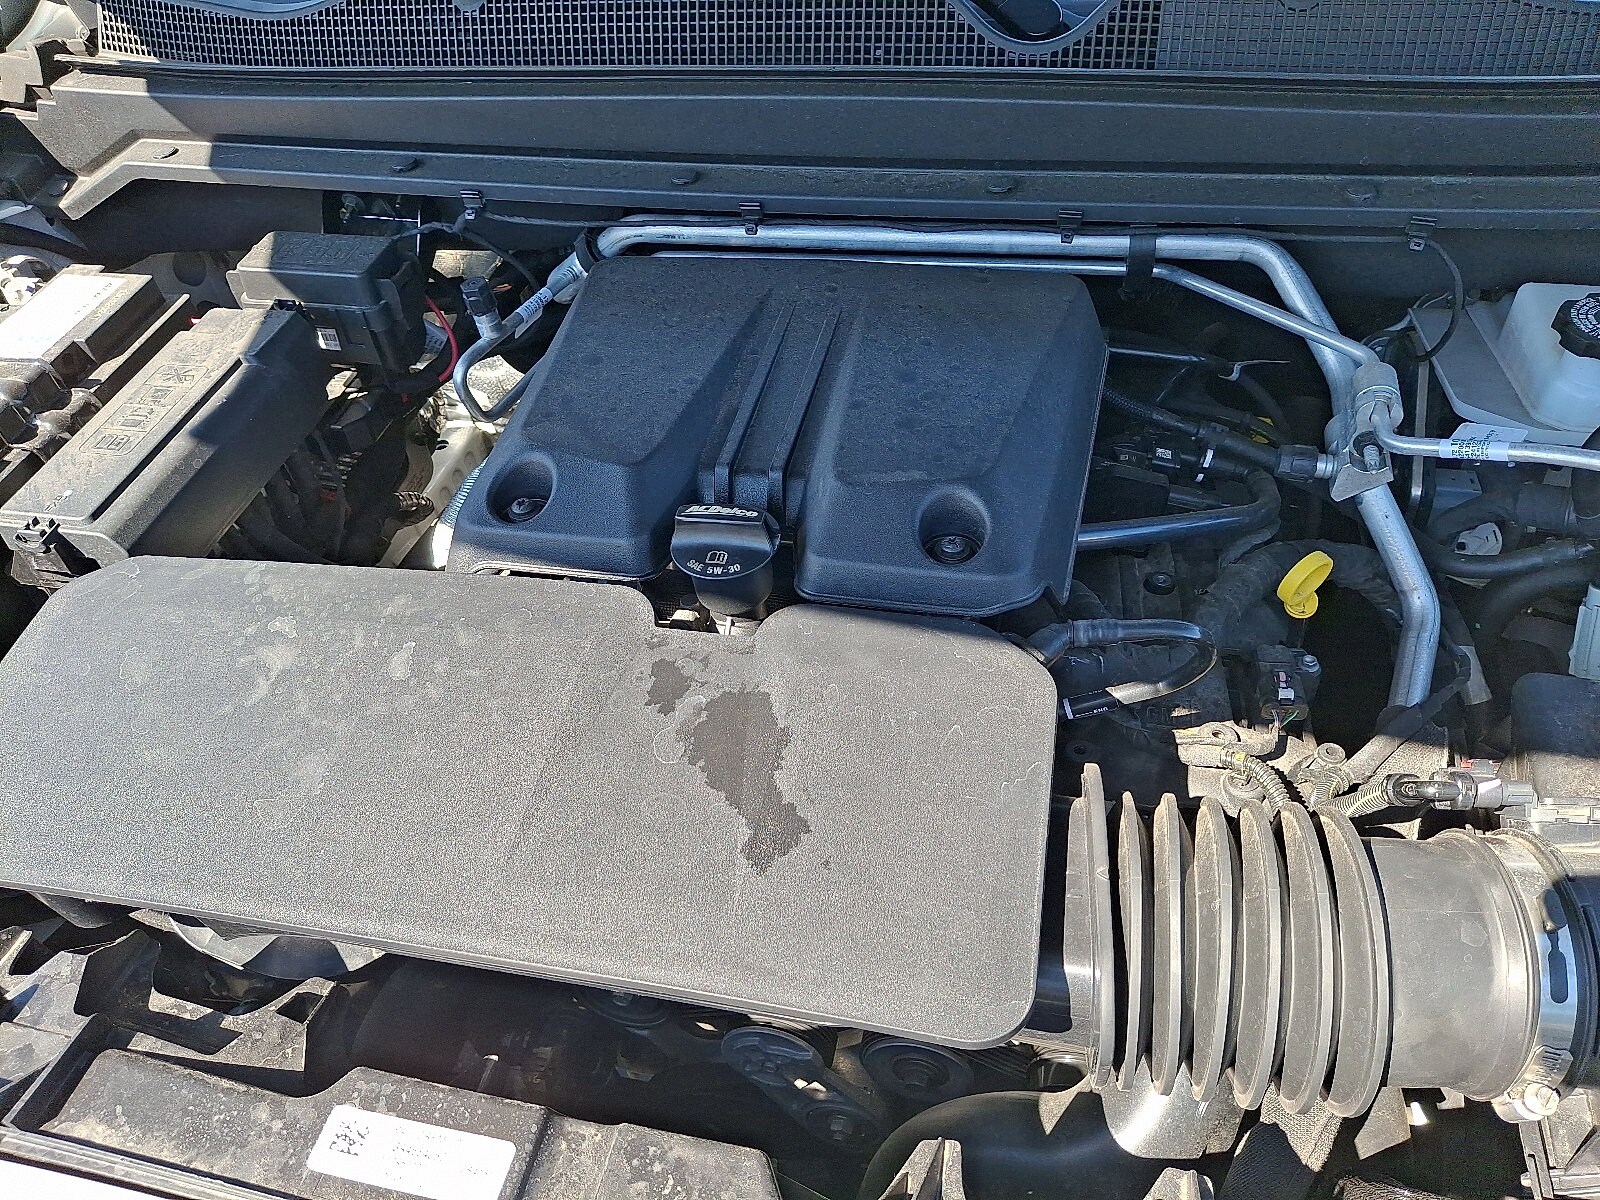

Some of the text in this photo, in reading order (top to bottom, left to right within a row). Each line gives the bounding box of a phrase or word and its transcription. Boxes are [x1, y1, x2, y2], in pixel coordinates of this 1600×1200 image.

[686, 506, 758, 517] ACDelco
[687, 560, 740, 574] SAE 5W-30
